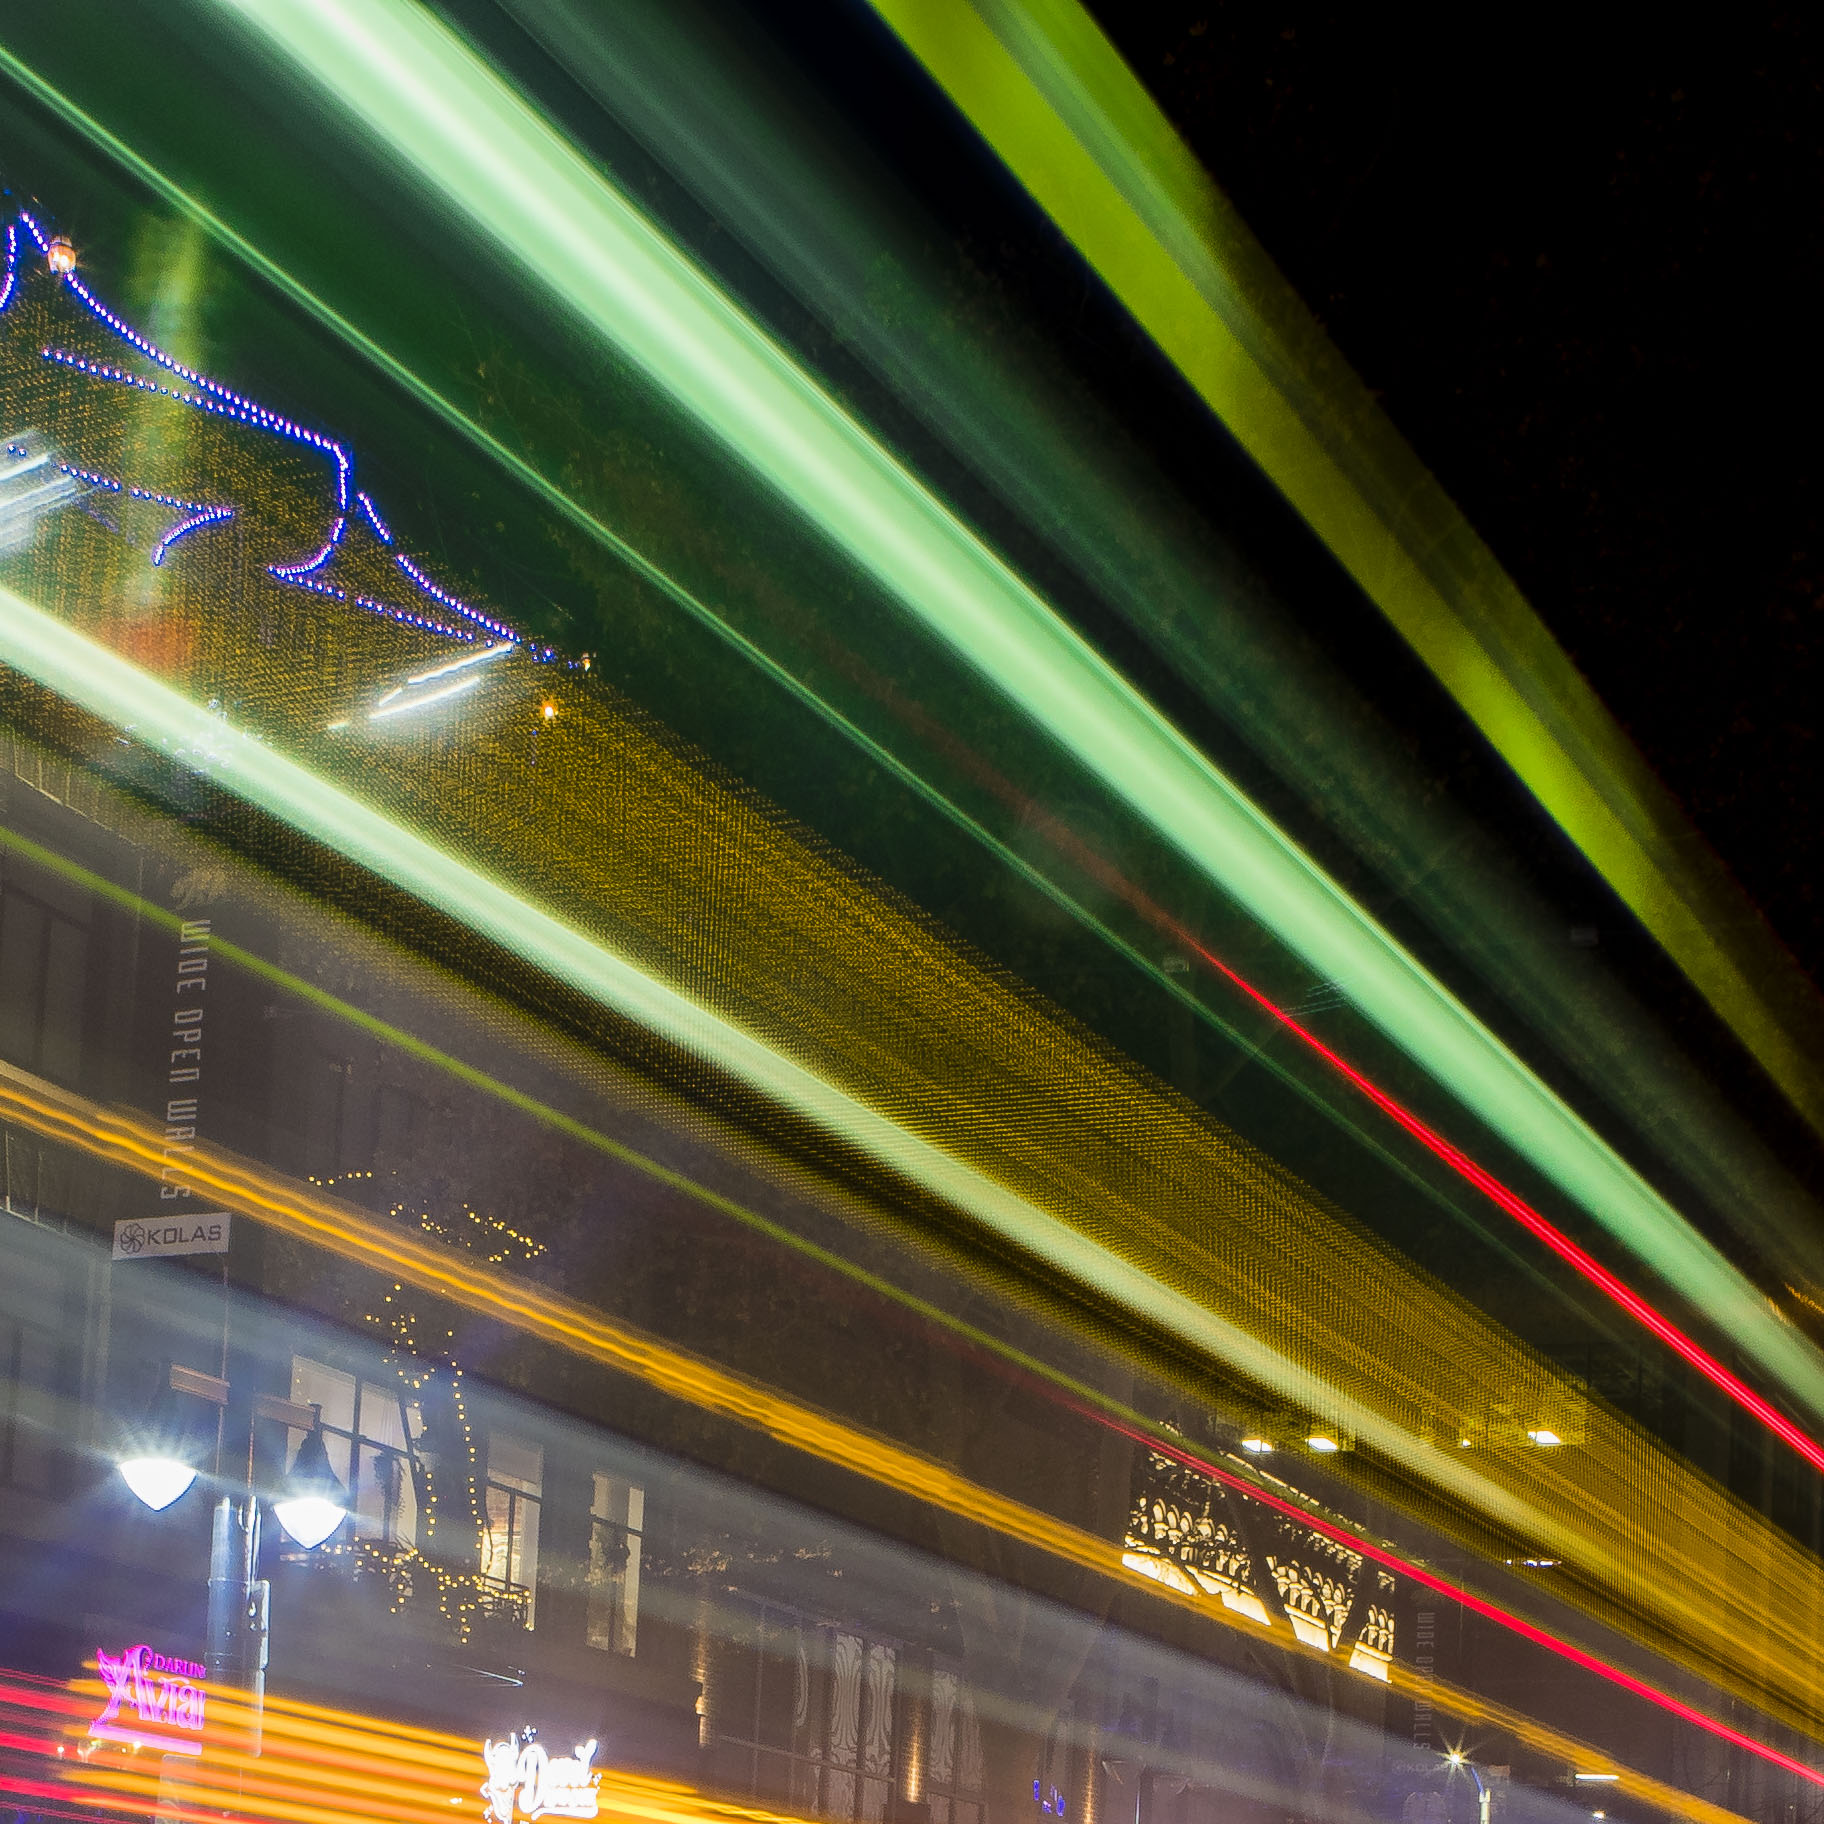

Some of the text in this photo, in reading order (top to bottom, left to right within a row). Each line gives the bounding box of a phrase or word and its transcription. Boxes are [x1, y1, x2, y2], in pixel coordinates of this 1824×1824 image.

[160, 919, 211, 1199] WIDE OPEN WALLS
[147, 1224, 223, 1246] KOLAS
